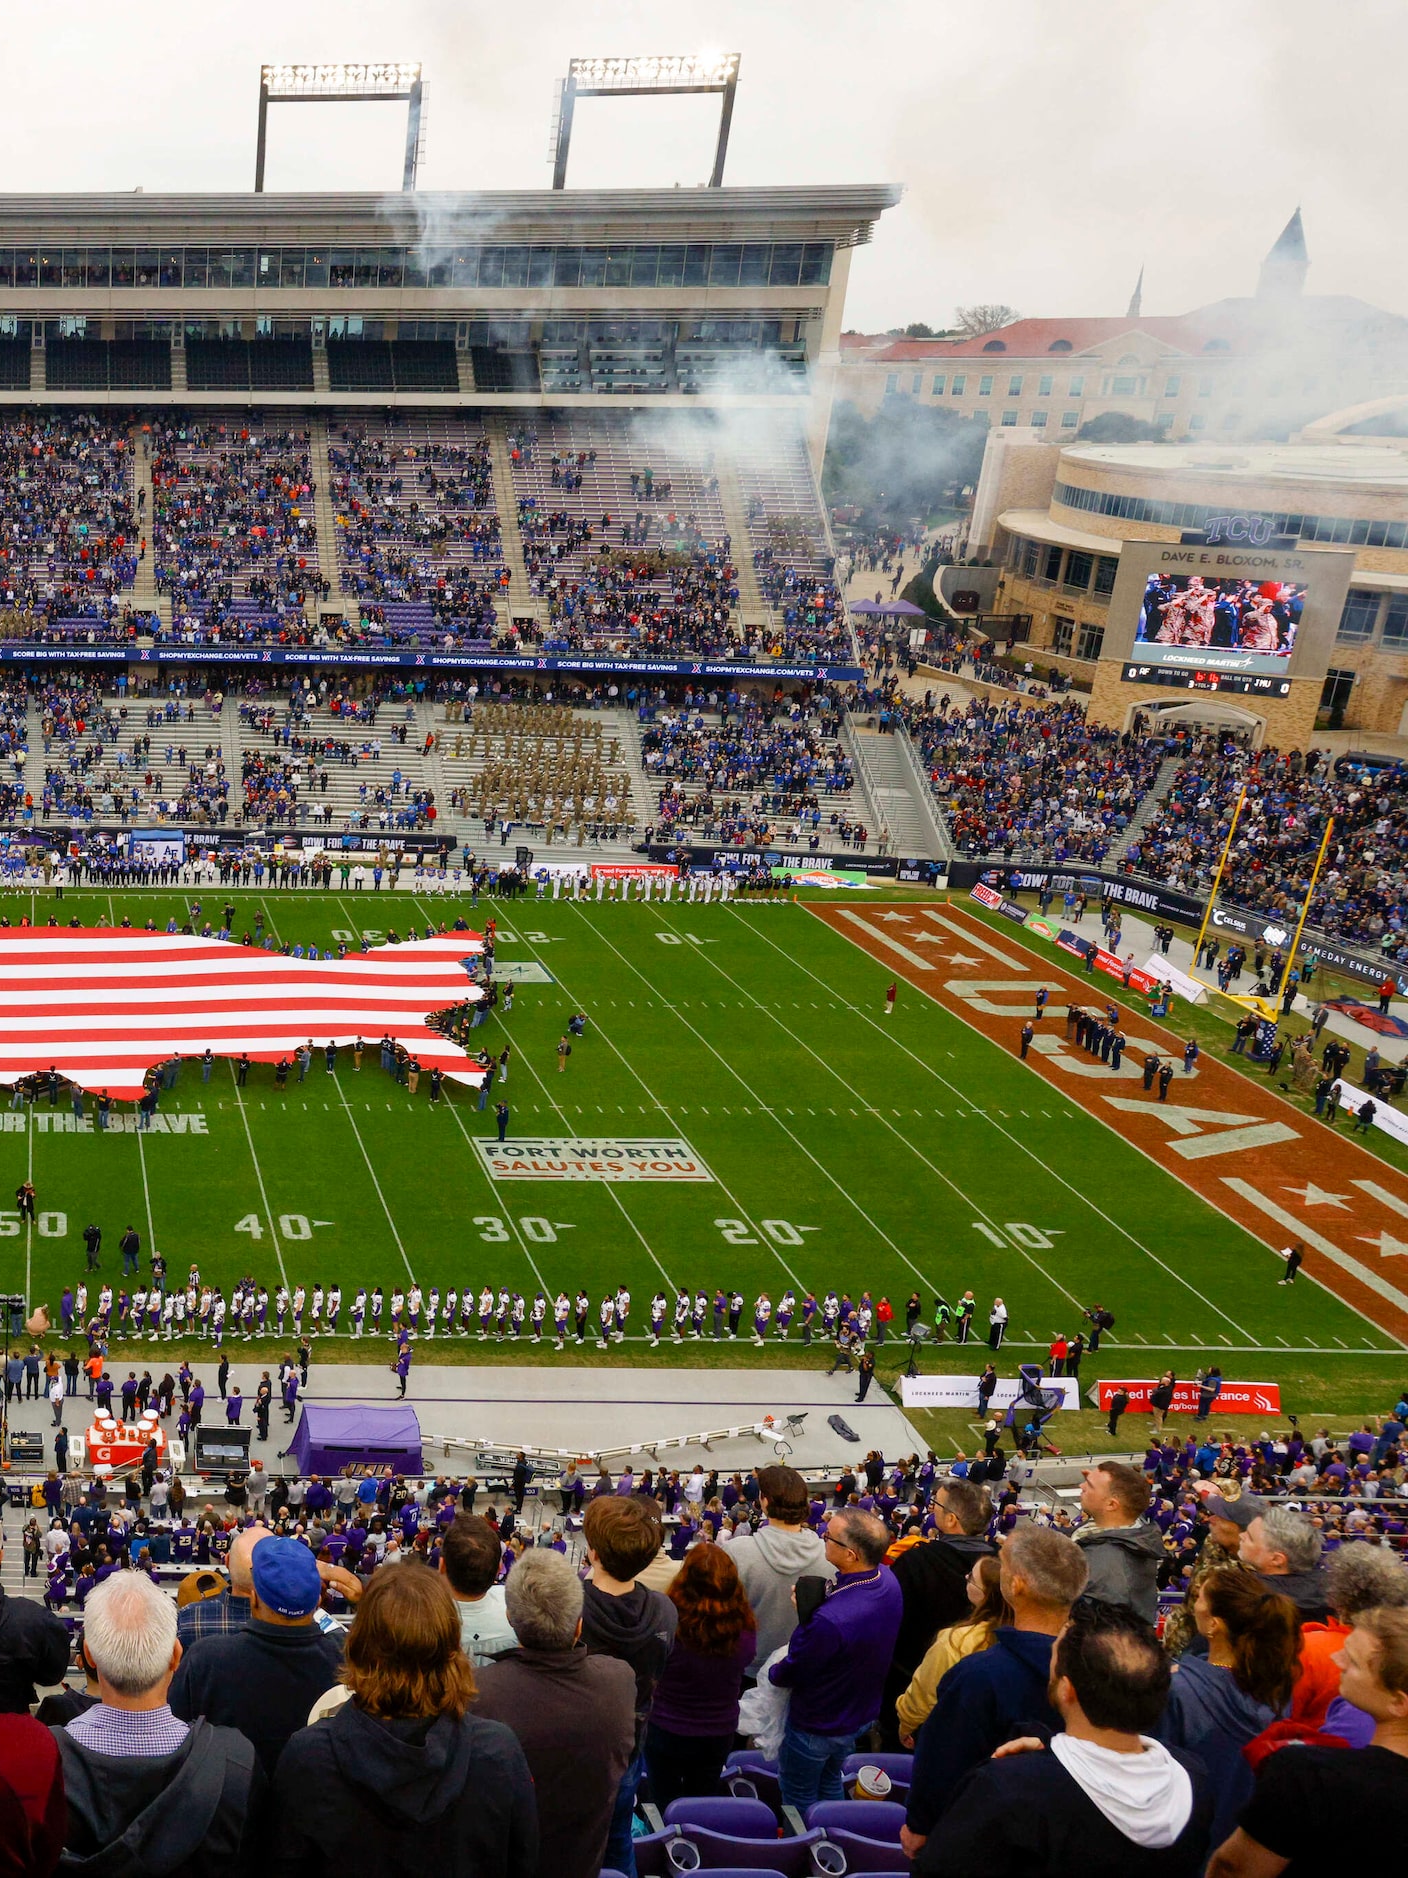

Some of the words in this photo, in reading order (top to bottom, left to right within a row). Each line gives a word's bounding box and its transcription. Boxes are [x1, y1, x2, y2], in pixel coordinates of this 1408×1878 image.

[1204, 516, 1276, 546] TCU
[1161, 551, 1195, 563] DAVE
[1199, 553, 1211, 564] E.
[1284, 558, 1305, 570] SR.
[97, 651, 125, 659] SAVINGS
[159, 652, 258, 660] SHOPMYEXCHANGE.COM/VETS
[432, 657, 534, 667] SHOPMYEXCHANGE.COM/VETS
[582, 661, 594, 669] BIG
[615, 663, 646, 671] TAX-FREE
[647, 664, 677, 672] SAVINGS
[1163, 655, 1206, 666] LOCKHEED
[1206, 659, 1239, 668] MARTIN
[705, 665, 814, 676] SHOPMYEXCHANGE.COM/VETS
[1128, 668, 1137, 678] 0
[1139, 667, 1151, 676] AF
[1188, 680, 1195, 689] 3
[1210, 683, 1218, 691] 3
[1244, 683, 1249, 691] 1
[1254, 679, 1272, 688] JMU
[1280, 683, 1290, 694] 0
[193, 834, 220, 845] BRAVE
[302, 837, 325, 848] BOWL
[327, 838, 343, 848] FOR
[362, 839, 377, 849] THE
[742, 853, 761, 865] FOR
[782, 855, 802, 868] THE
[802, 857, 834, 870] BRAVE
[1102, 880, 1124, 901] THE
[1125, 888, 1159, 911] BRAVE
[1159, 902, 1179, 912] LOCKHEED
[1223, 917, 1247, 929] CELSIUS
[655, 932, 704, 945] 10
[1300, 942, 1346, 965] GAMEDAY
[1349, 960, 1389, 982] ENERGY
[33, 1112, 95, 1134] THE
[103, 1113, 210, 1135] BRAVE
[485, 1146, 562, 1157] FORT
[570, 1147, 688, 1159] WORTH
[492, 1160, 625, 1172] SALUTES
[629, 1161, 696, 1173] YOU
[234, 1213, 313, 1241] 40
[472, 1216, 558, 1243] 30
[713, 1219, 805, 1246] 20
[972, 1222, 1055, 1249] 10
[96, 1447, 112, 1462] G
[339, 1461, 393, 1476] JMU
[395, 1489, 407, 1499] 20
[179, 1535, 192, 1547] 23
[215, 1539, 228, 1550] 23
[277, 1606, 288, 1614] AIR
[288, 1608, 305, 1616] FORCE
